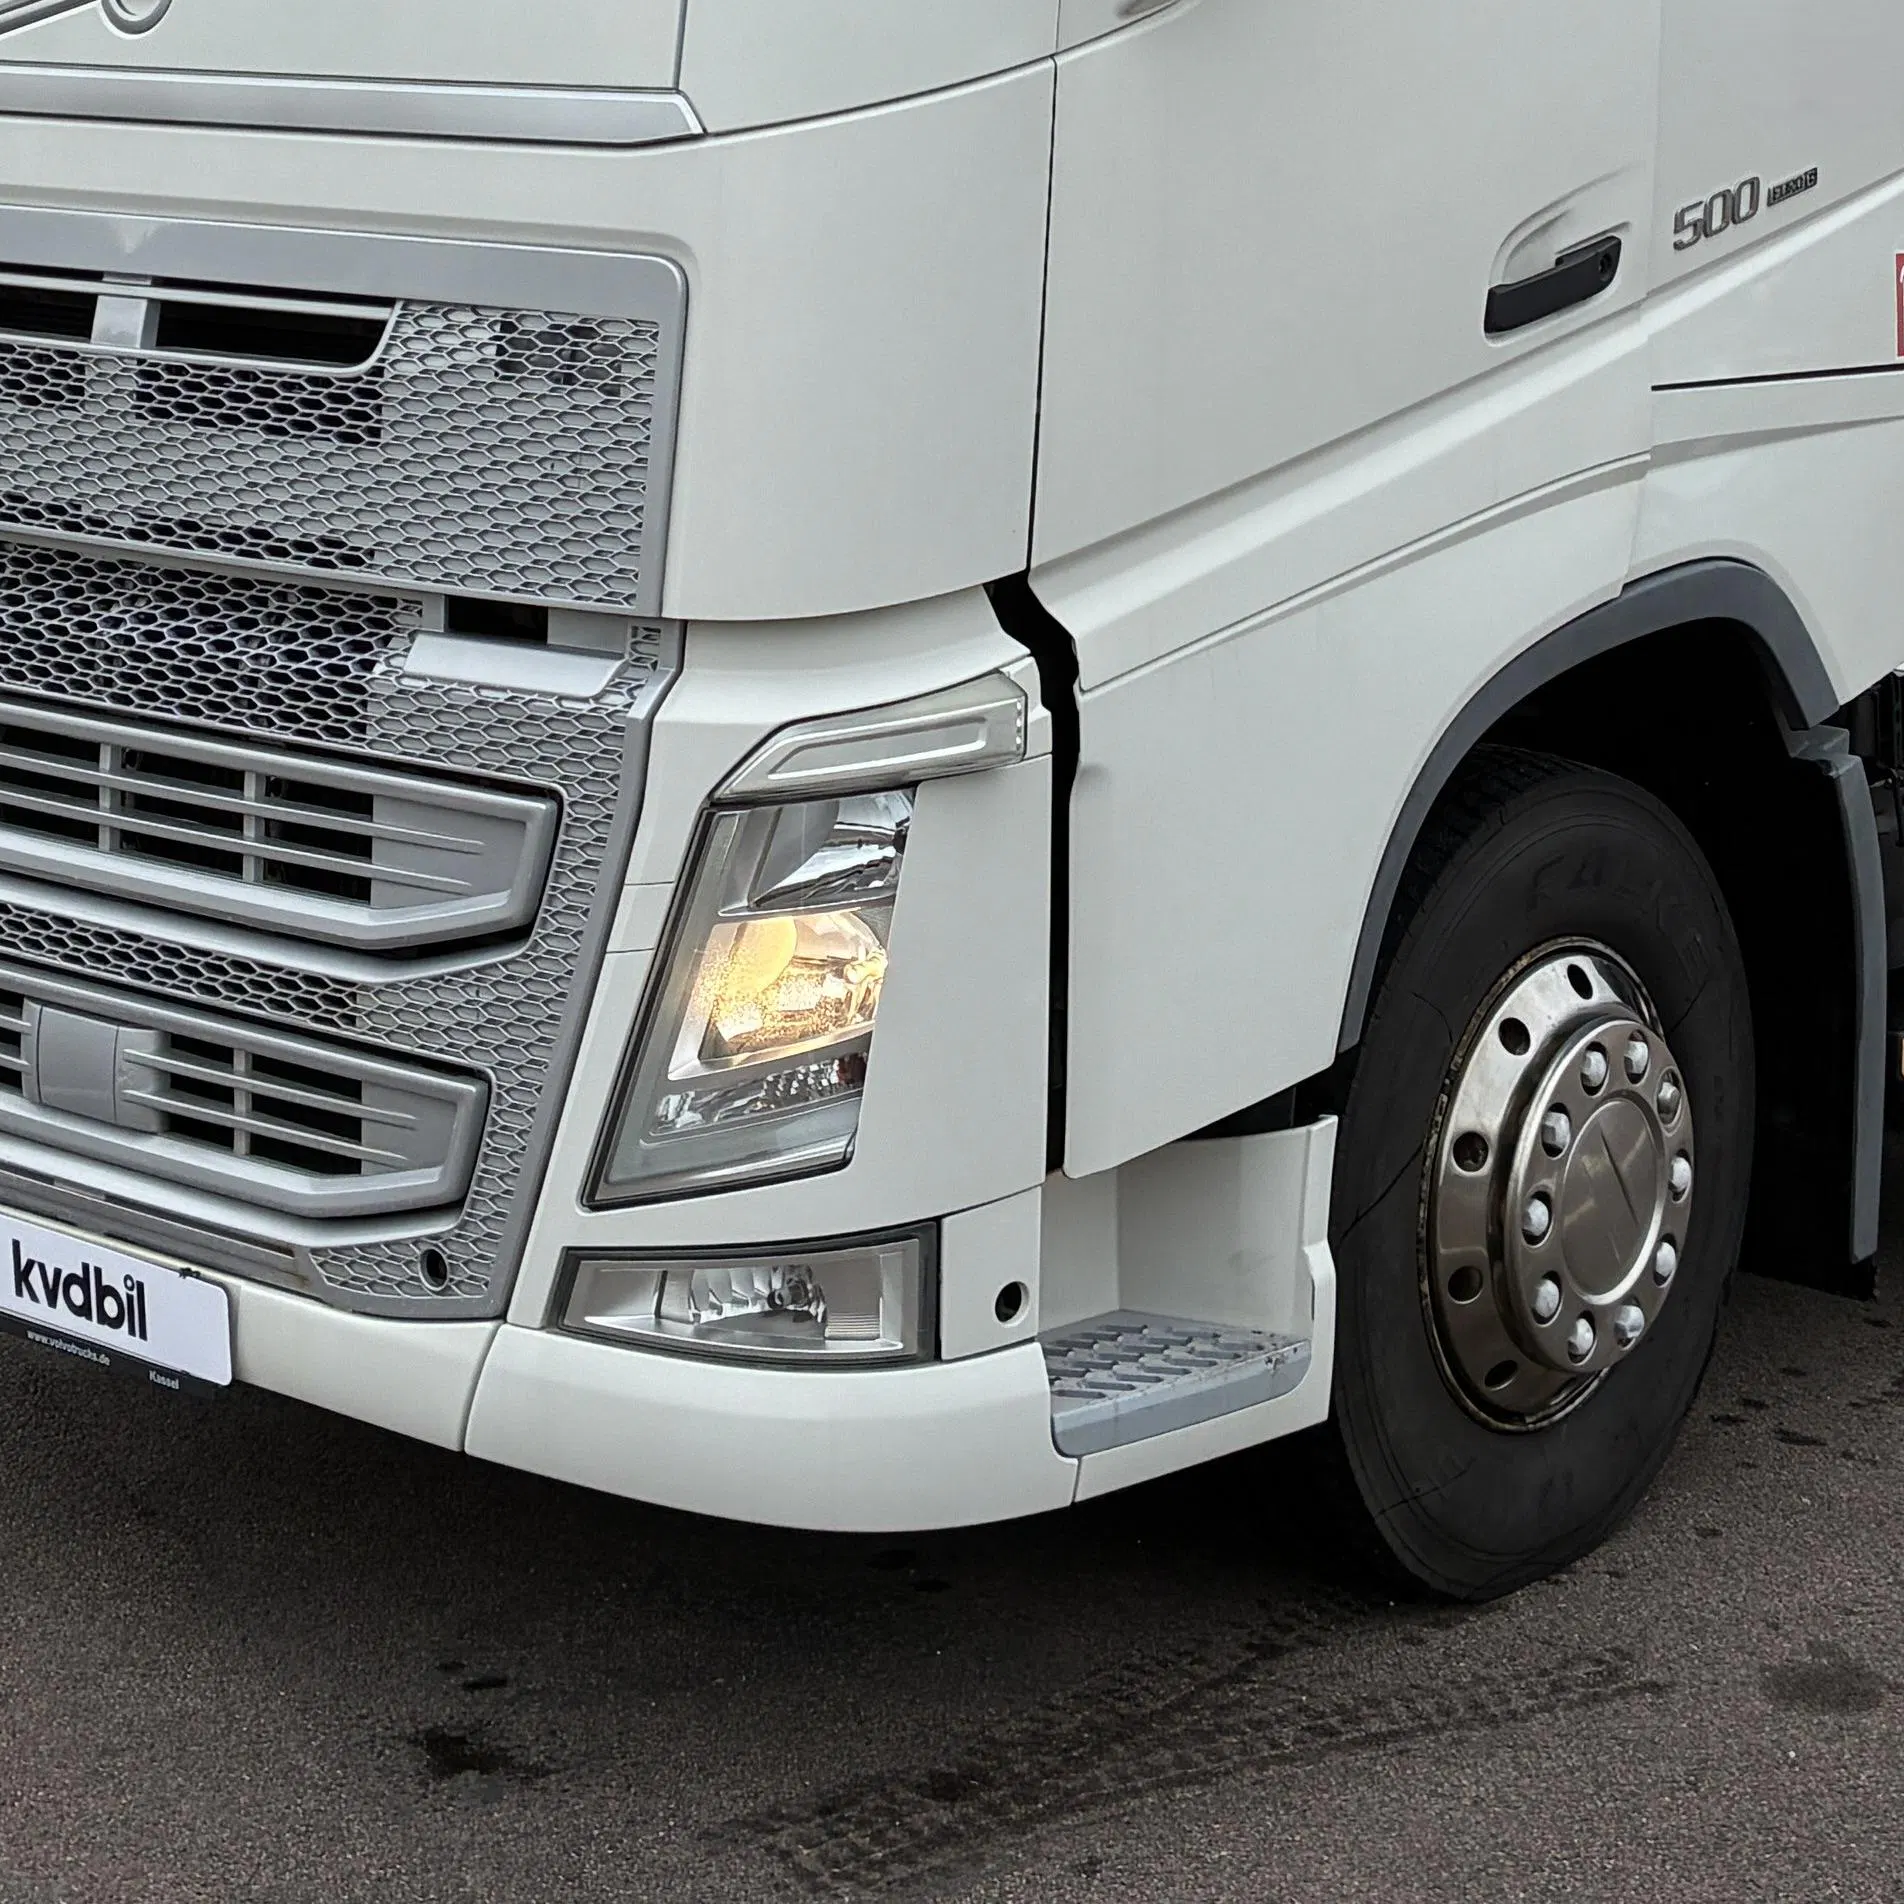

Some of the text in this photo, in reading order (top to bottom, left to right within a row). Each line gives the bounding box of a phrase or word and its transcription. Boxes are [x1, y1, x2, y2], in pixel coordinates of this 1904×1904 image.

[1672, 176, 1761, 251] 500
[12, 1238, 148, 1342] kvdbil
[26, 1330, 111, 1367] www.volvotrucks.de
[149, 1370, 180, 1390] Kassel
